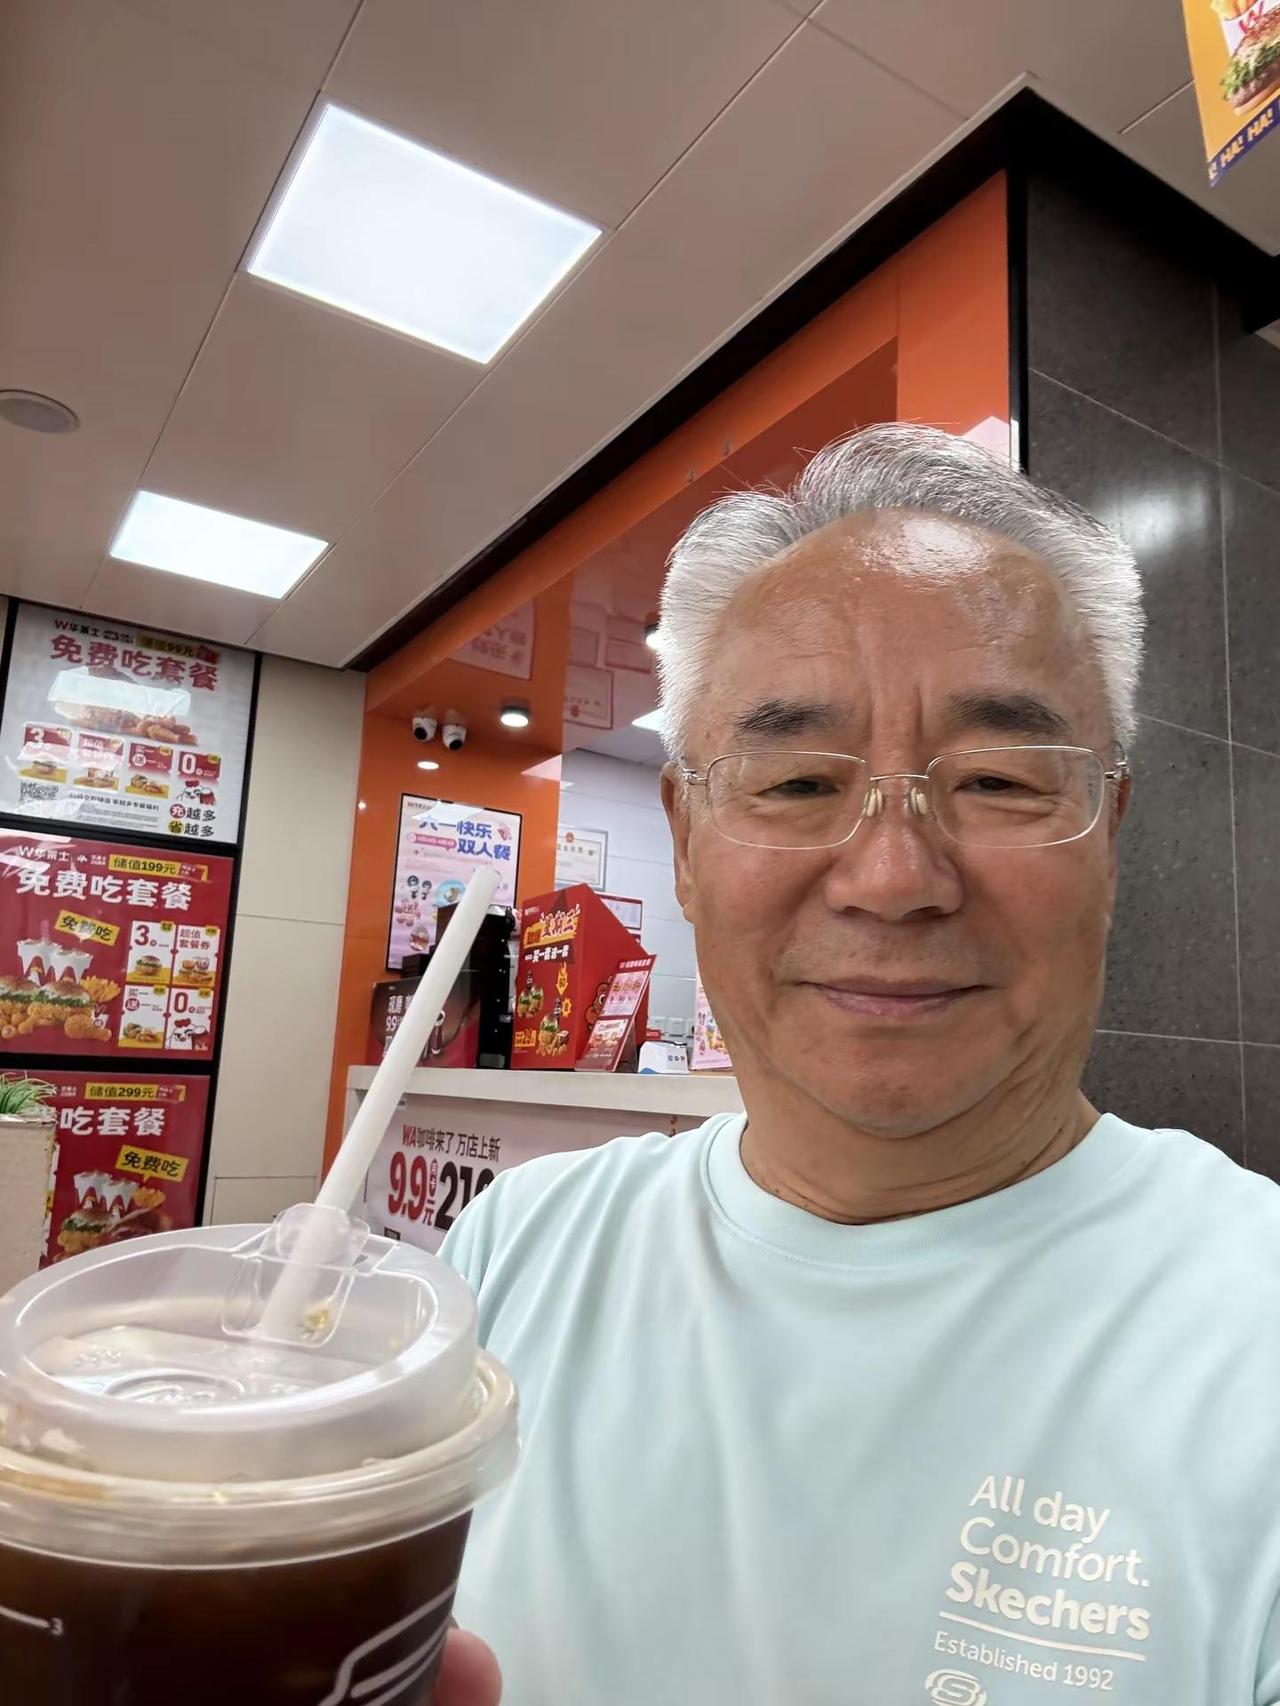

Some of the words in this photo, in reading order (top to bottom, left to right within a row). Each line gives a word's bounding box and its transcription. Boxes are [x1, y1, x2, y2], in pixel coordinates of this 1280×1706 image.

[50, 634, 218, 691] 免费吃套餐
[170, 803, 216, 822] 充越多
[419, 814, 492, 840] 六一快乐
[457, 838, 511, 860] 双人餐
[113, 857, 177, 875] 储值199元
[16, 868, 192, 910] 免费吃套餐
[62, 915, 113, 941] 免费吃
[135, 924, 150, 946] 3
[174, 992, 189, 1013] 0
[89, 1085, 155, 1099] 储值299元
[402, 1124, 455, 1154] WA咖啡来了
[456, 1132, 501, 1162] 万店上新
[122, 1150, 181, 1178] 免费吃
[968, 1474, 1026, 1517] All
[1033, 1491, 1111, 1544] day
[960, 1516, 1150, 1588] Comfort.
[945, 1561, 1151, 1641] Skechers
[934, 1630, 1058, 1683] Established
[1062, 1663, 1114, 1691] 1992
